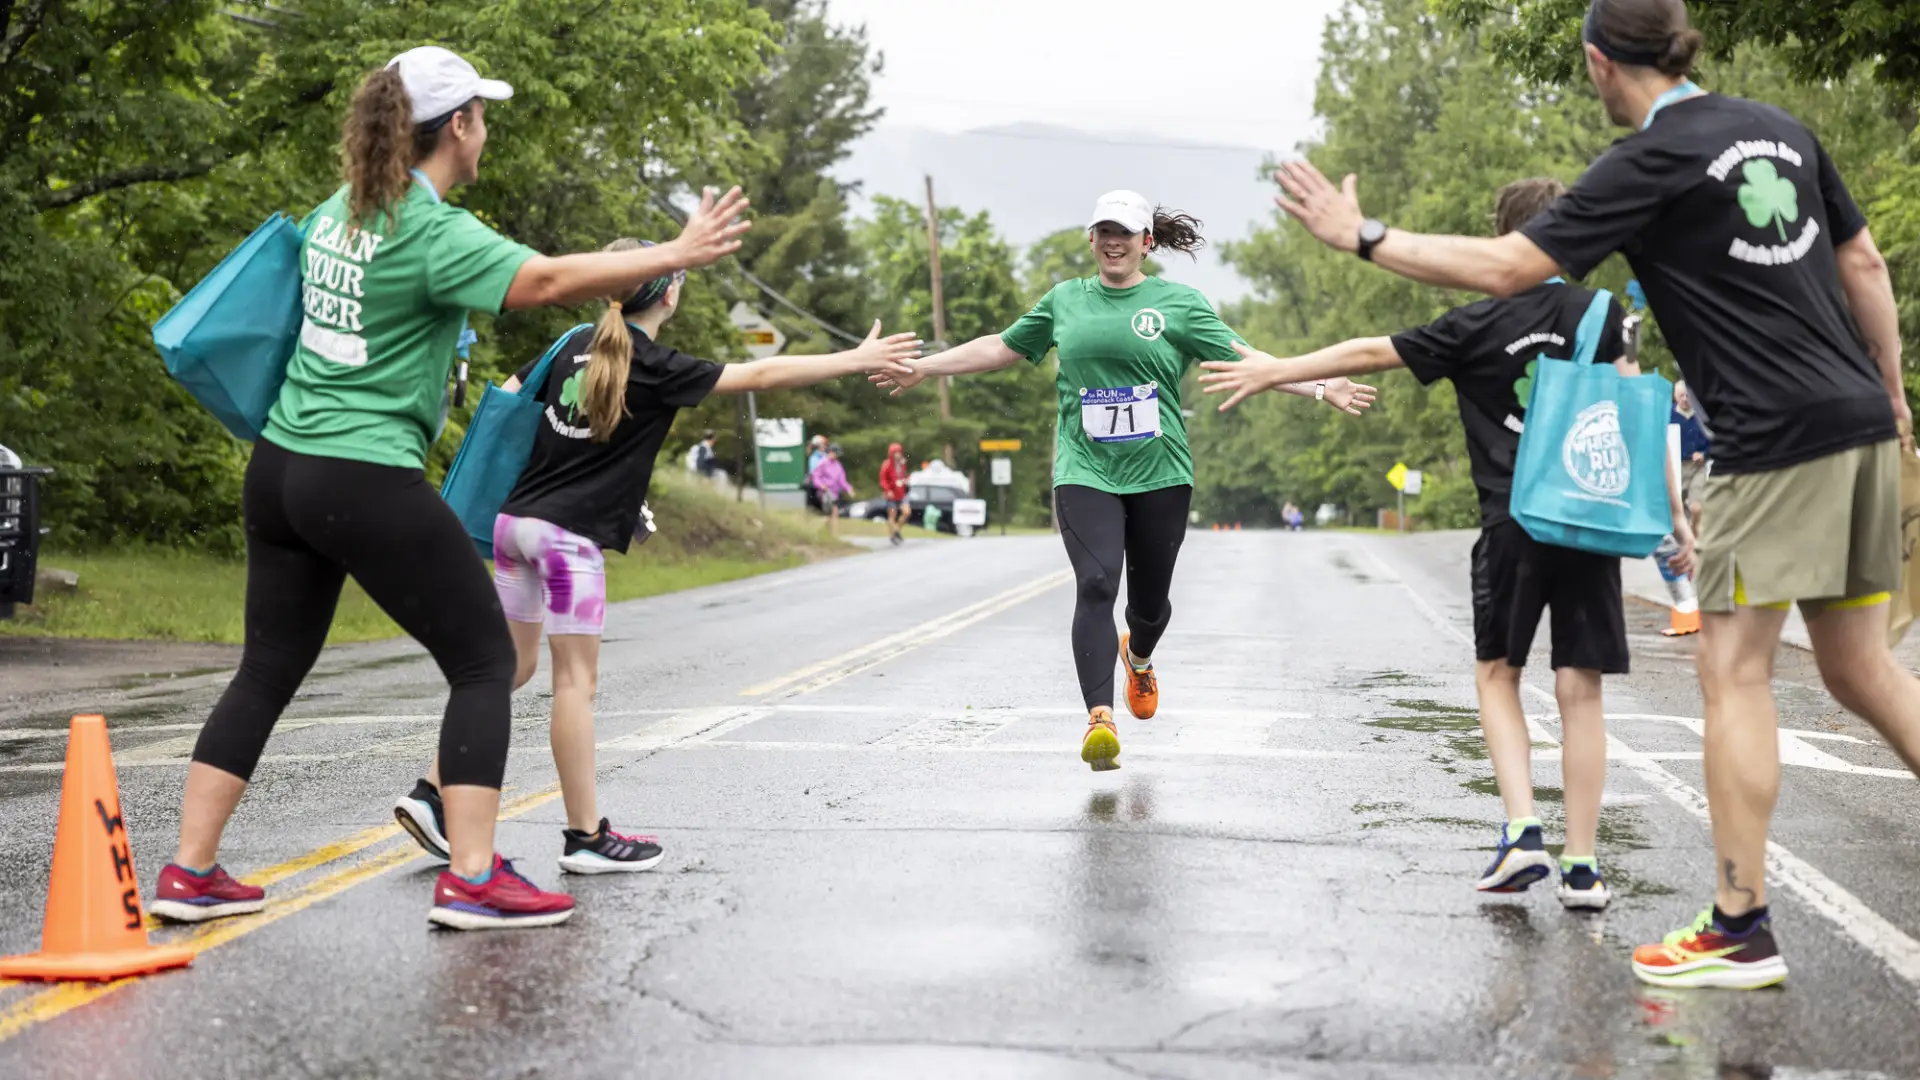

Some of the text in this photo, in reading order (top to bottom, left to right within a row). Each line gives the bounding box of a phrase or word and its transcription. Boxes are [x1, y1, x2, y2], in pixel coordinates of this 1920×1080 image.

[310, 215, 384, 263] EARN
[306, 247, 365, 297] YOUR
[1096, 389, 1118, 398] RUN
[1105, 404, 1135, 434] 71
[1590, 448, 1620, 471] RU
[95, 799, 141, 930] WHS
